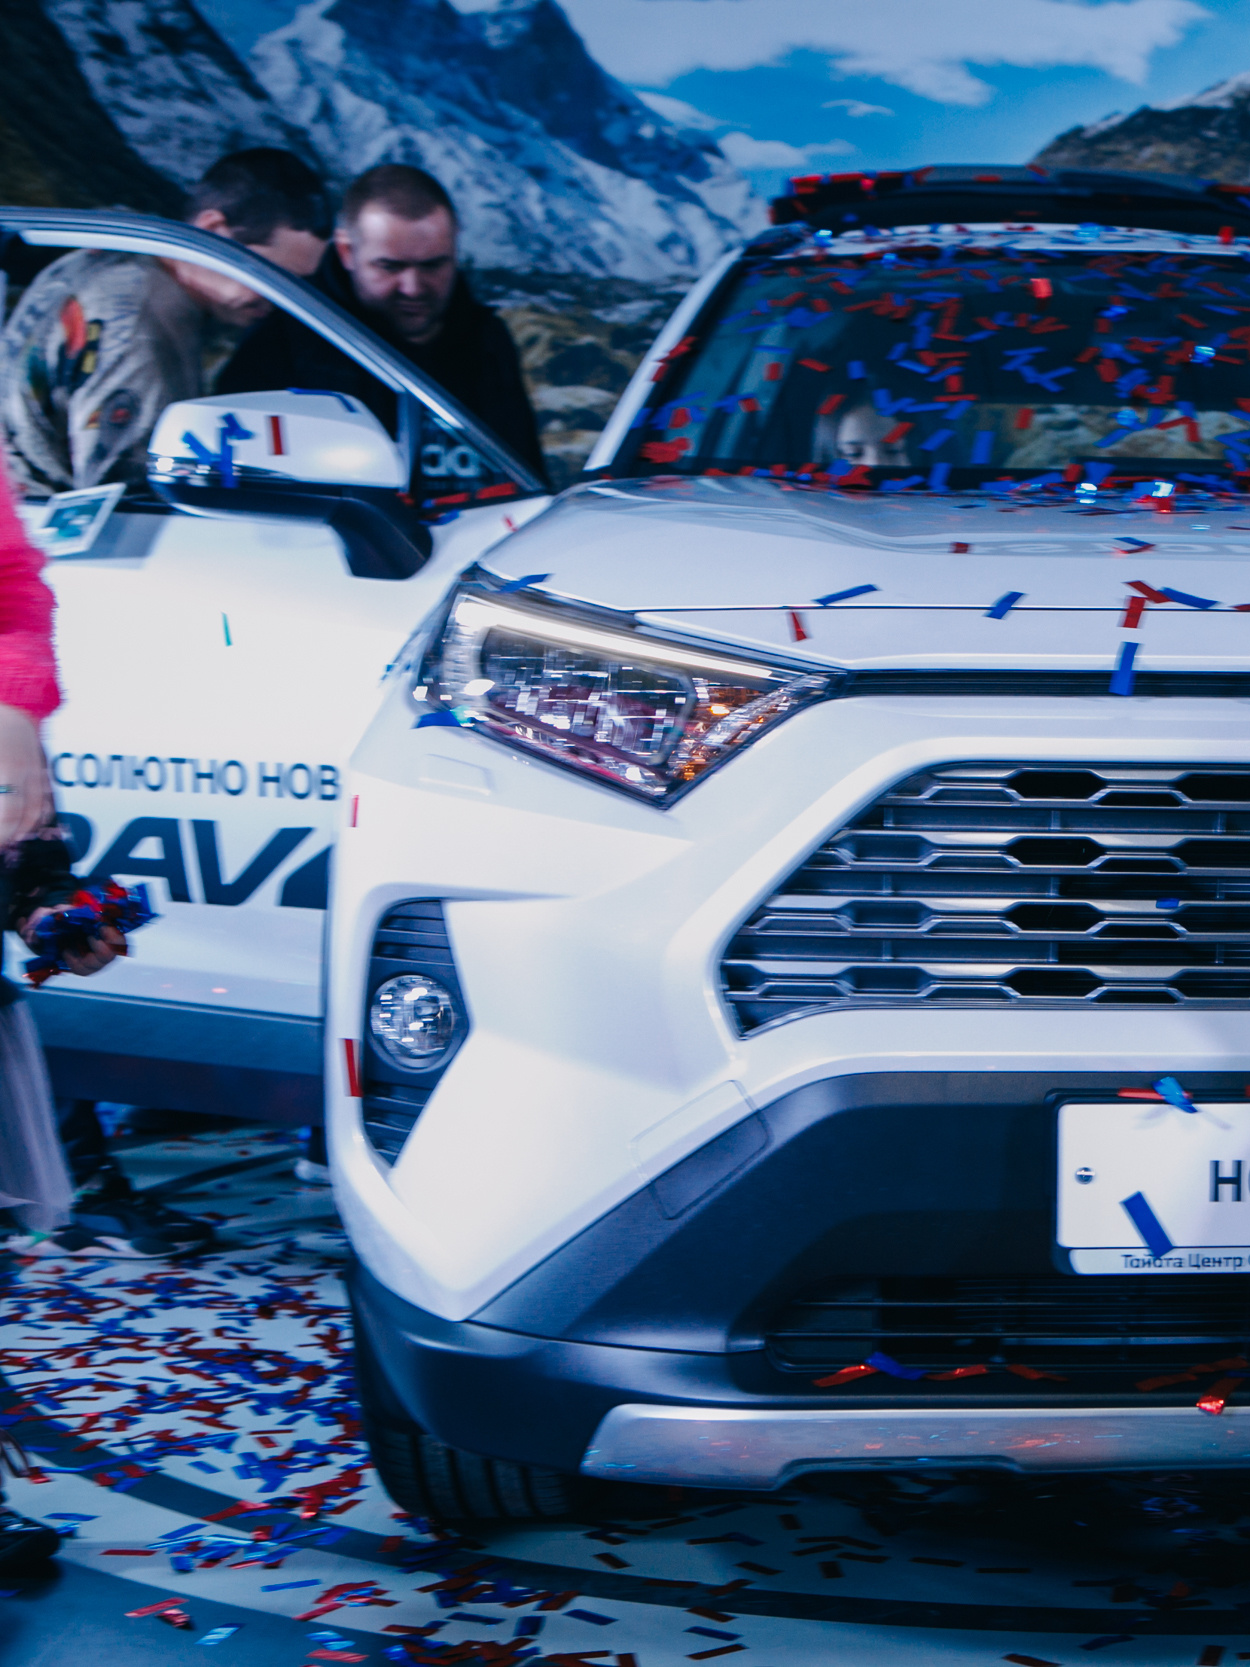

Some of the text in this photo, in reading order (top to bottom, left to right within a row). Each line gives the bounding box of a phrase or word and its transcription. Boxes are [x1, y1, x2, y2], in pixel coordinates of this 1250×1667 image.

[52, 752, 341, 801] СОЛЮТНО НОВ
[1121, 1252, 1184, 1269] Тойота
[1187, 1252, 1244, 1271] Центр
